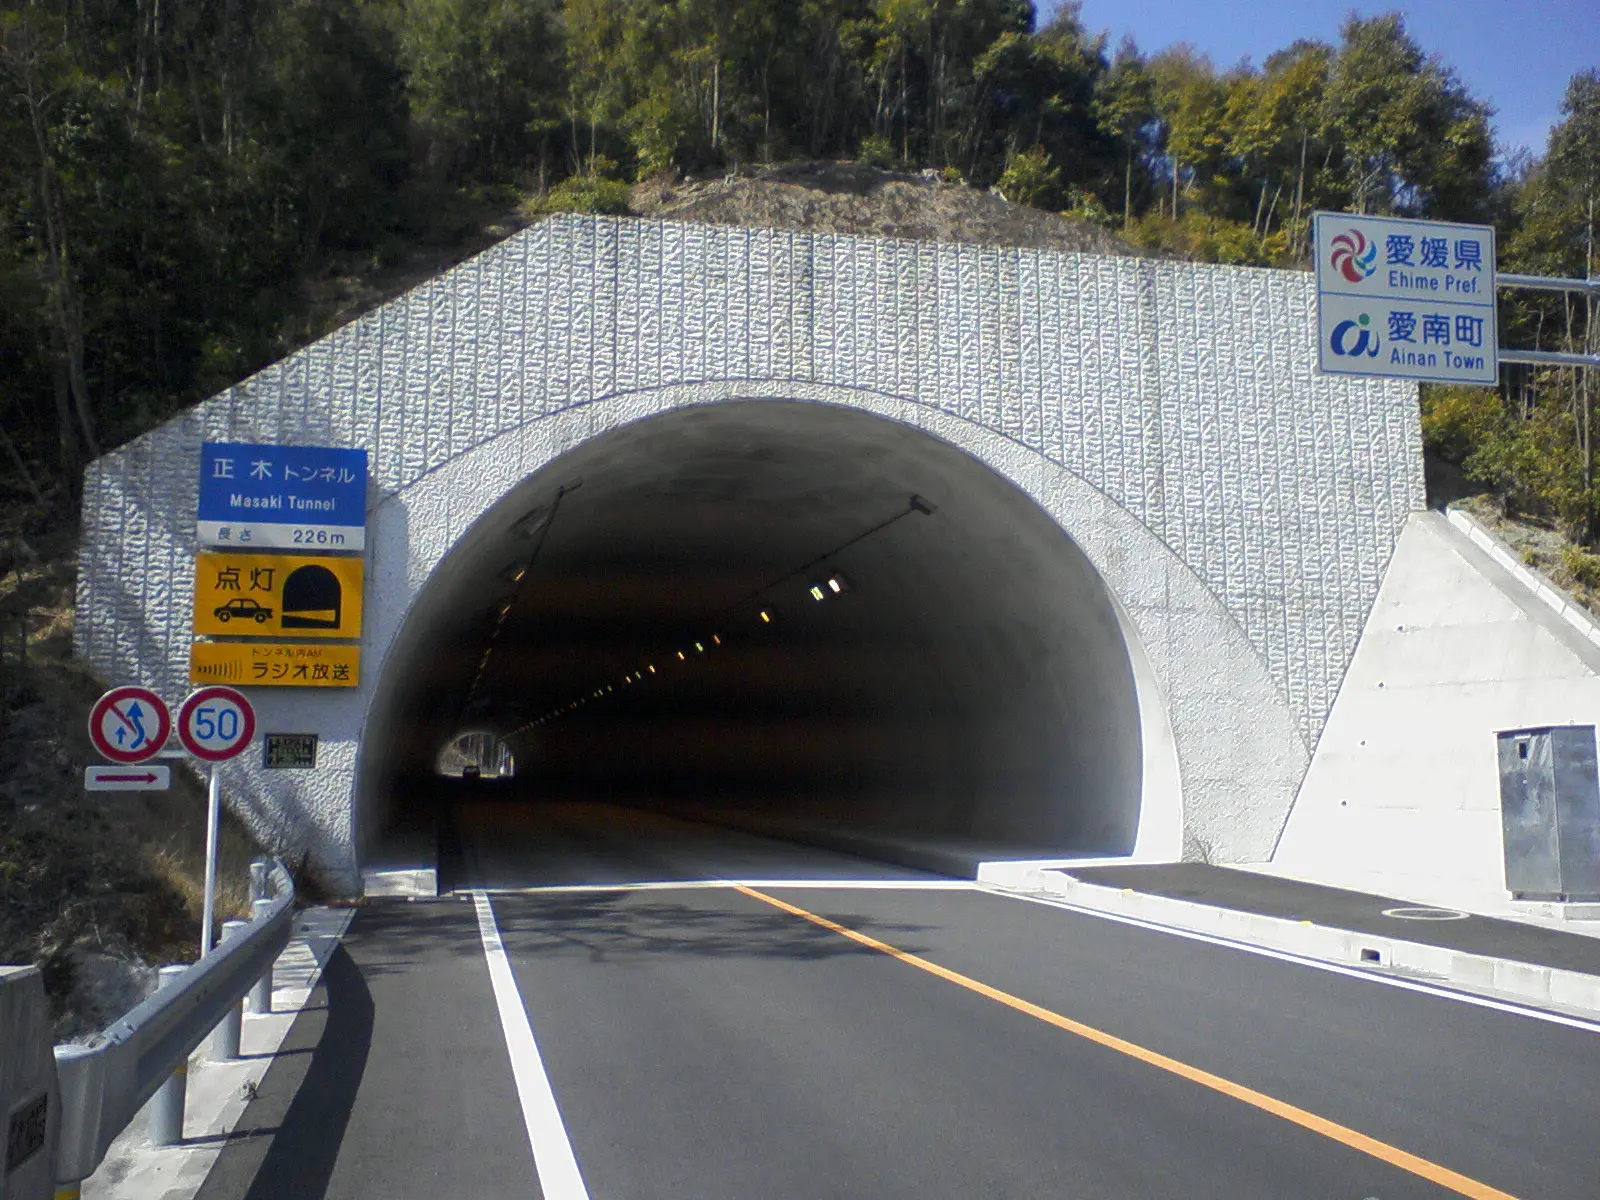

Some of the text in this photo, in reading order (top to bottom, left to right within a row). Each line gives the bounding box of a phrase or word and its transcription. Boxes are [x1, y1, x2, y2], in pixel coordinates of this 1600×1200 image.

[1386, 234, 1482, 272] 愛媛県
[1388, 271, 1482, 295] Ehime Pref.
[1387, 311, 1484, 347] 愛南町
[1390, 348, 1485, 370] Ainan Town
[230, 494, 335, 511] Masaki Tunnel
[218, 527, 345, 544] 長さ 226m
[214, 566, 276, 592] 点灯
[252, 662, 350, 681] ラジオ放送
[195, 708, 238, 741] 50
